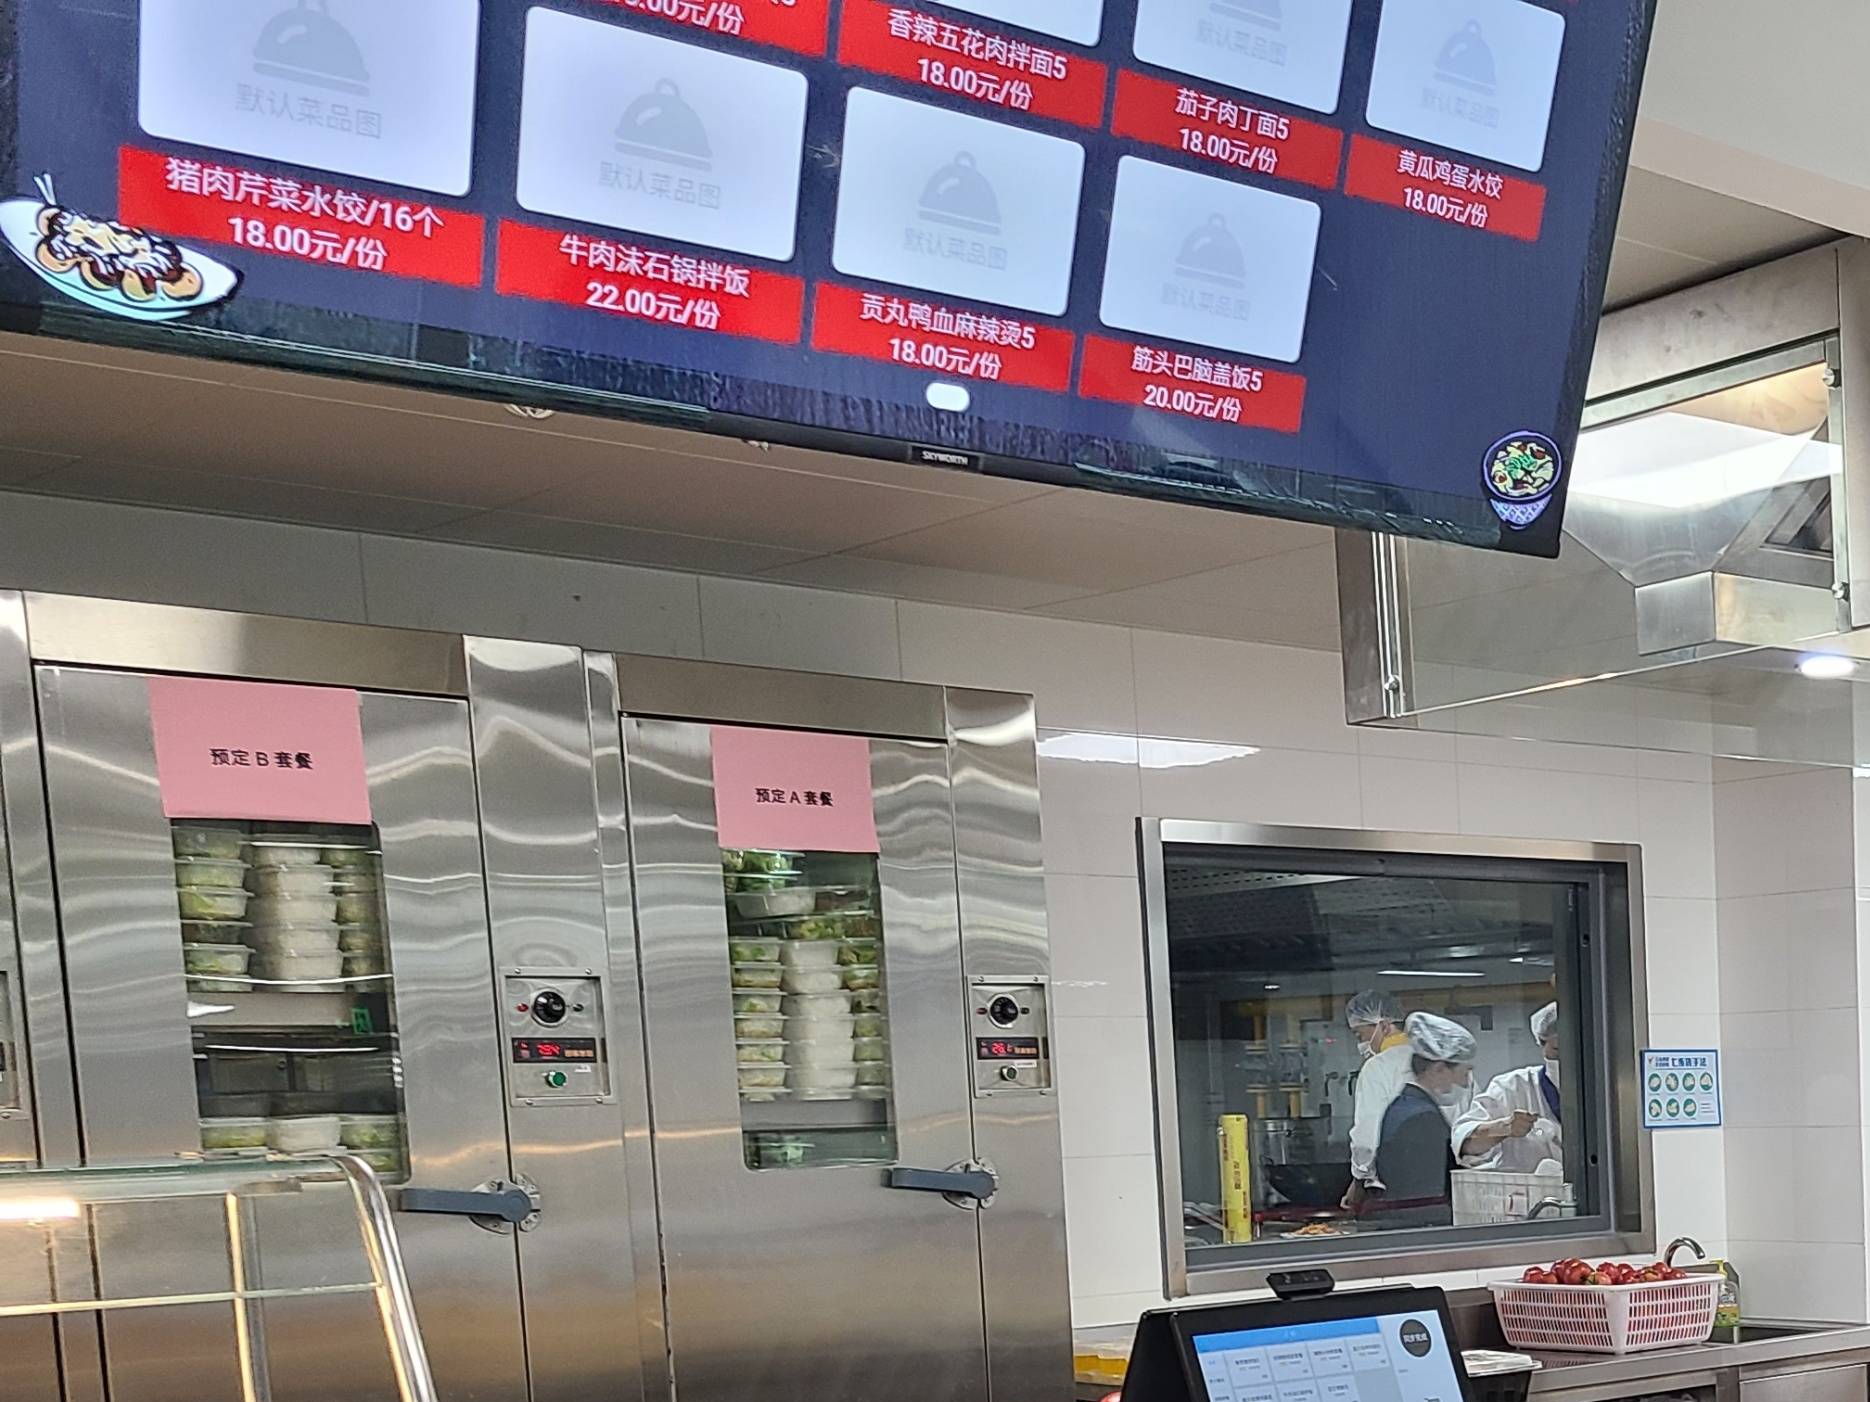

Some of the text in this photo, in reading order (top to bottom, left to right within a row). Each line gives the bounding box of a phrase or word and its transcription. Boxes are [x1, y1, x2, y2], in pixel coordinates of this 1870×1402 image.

[887, 8, 1068, 80] 香辣五花肉拌面5
[917, 58, 1033, 111] 18.00元/份
[235, 83, 382, 140] 默认菜品图
[1175, 87, 1290, 140] 茄子肉丁面5
[1179, 128, 1278, 174] 18.00元/份
[1397, 149, 1503, 199] 黄瓜鸡蛋水饺
[165, 156, 444, 238] 猪肉芹菜水饺/16个
[598, 160, 721, 210] 默认菜品图
[1403, 187, 1487, 228] 18.00元/份
[227, 217, 388, 271] 18.00元/份
[559, 234, 750, 298] 牛肉沫石锅拌饭
[586, 281, 721, 330] 22.00元/份
[859, 292, 1036, 350] 贡丸鸭血麻辣烫5
[889, 337, 1001, 380] 18.00元/份
[1131, 345, 1263, 392] 筋头巴脑盖饭5
[1143, 384, 1242, 423] 20.00元/份
